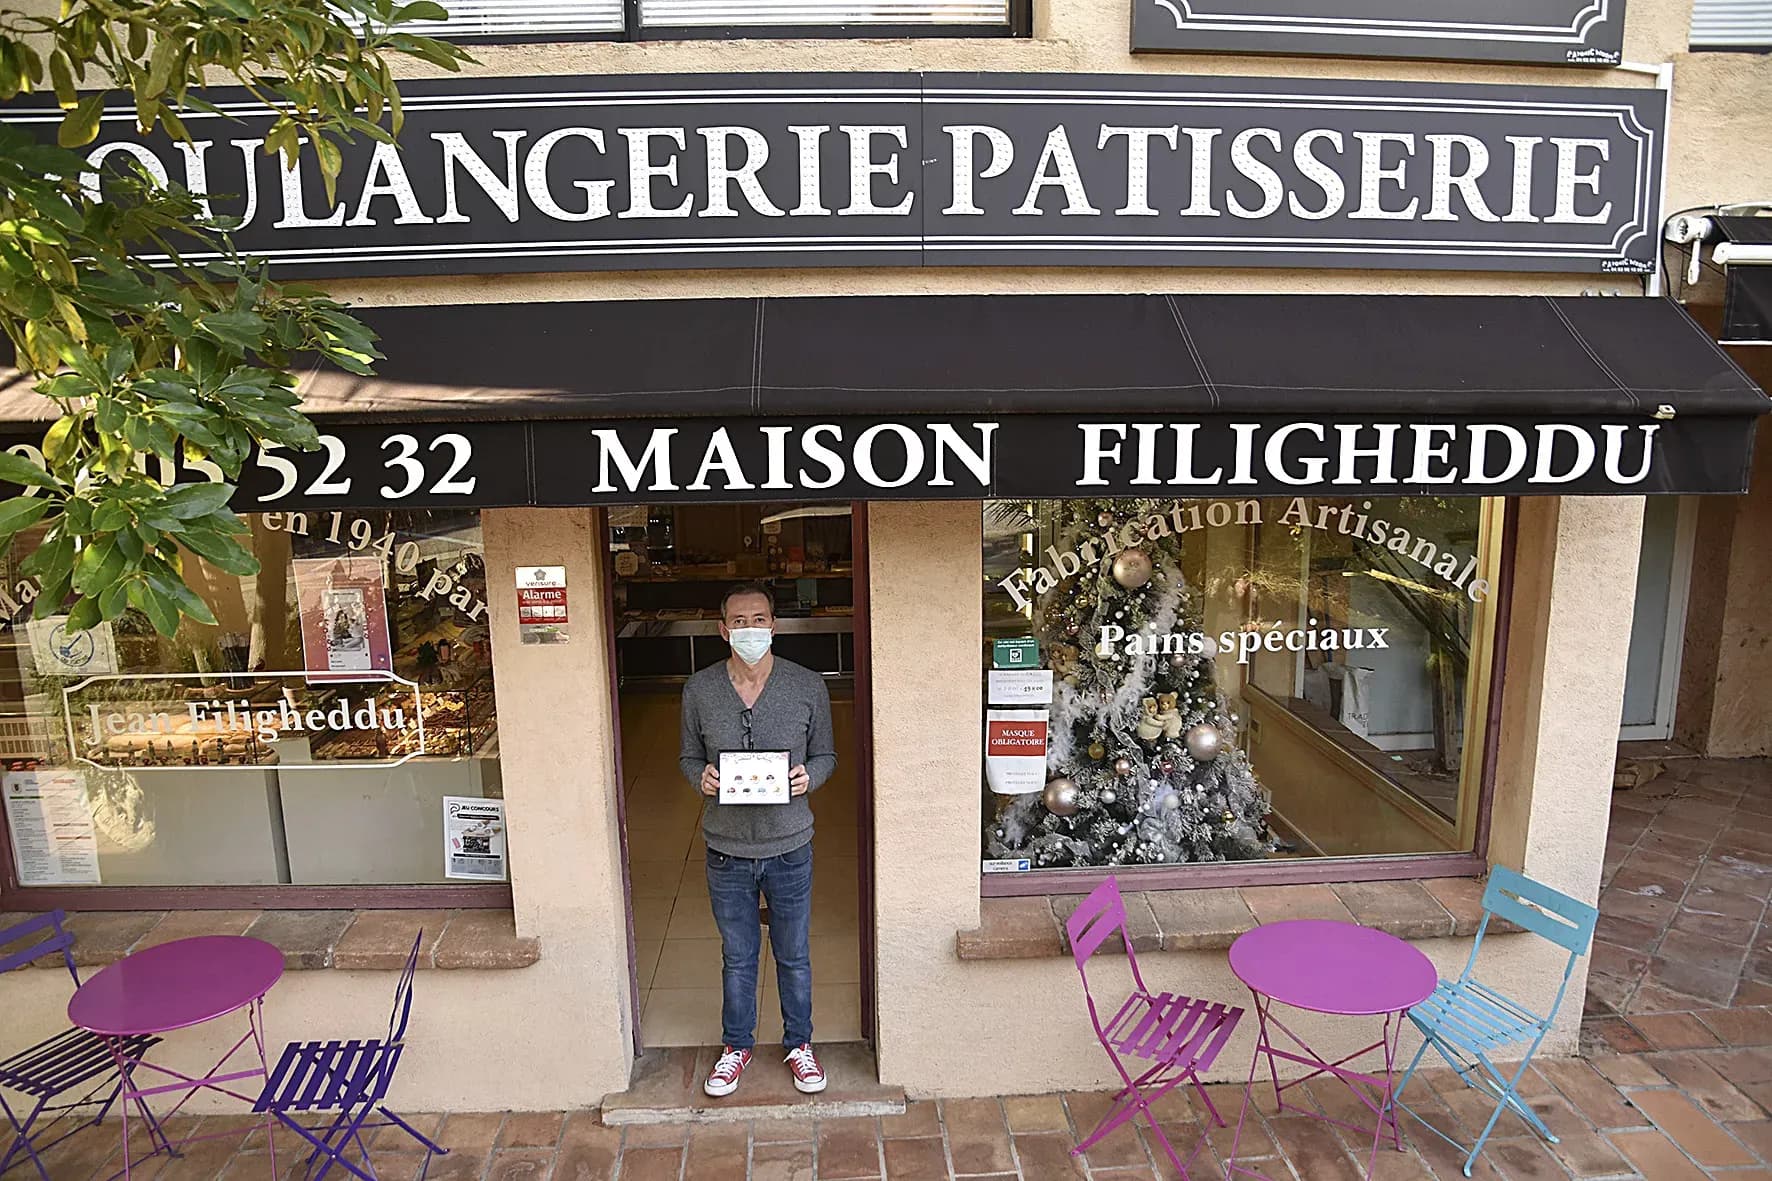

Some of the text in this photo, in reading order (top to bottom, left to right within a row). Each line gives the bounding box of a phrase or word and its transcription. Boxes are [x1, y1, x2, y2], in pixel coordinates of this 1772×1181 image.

[42, 123, 1613, 233] OULANGERIE PATISSERIE
[257, 434, 352, 503] 52
[380, 432, 478, 499] 32
[591, 422, 999, 493] MAISON
[1075, 422, 1661, 487] FILIGHEDDU
[262, 511, 309, 536] en
[325, 511, 421, 573] 1940
[997, 496, 1490, 612] Fabrication Artisanale
[523, 589, 561, 600] Alarme
[1097, 618, 1390, 664] Pains spéciaux
[86, 697, 407, 746] Jean Filigheddu
[992, 738, 1045, 746] OBLIGATOIRE
[1002, 729, 1035, 738] MASQUE
